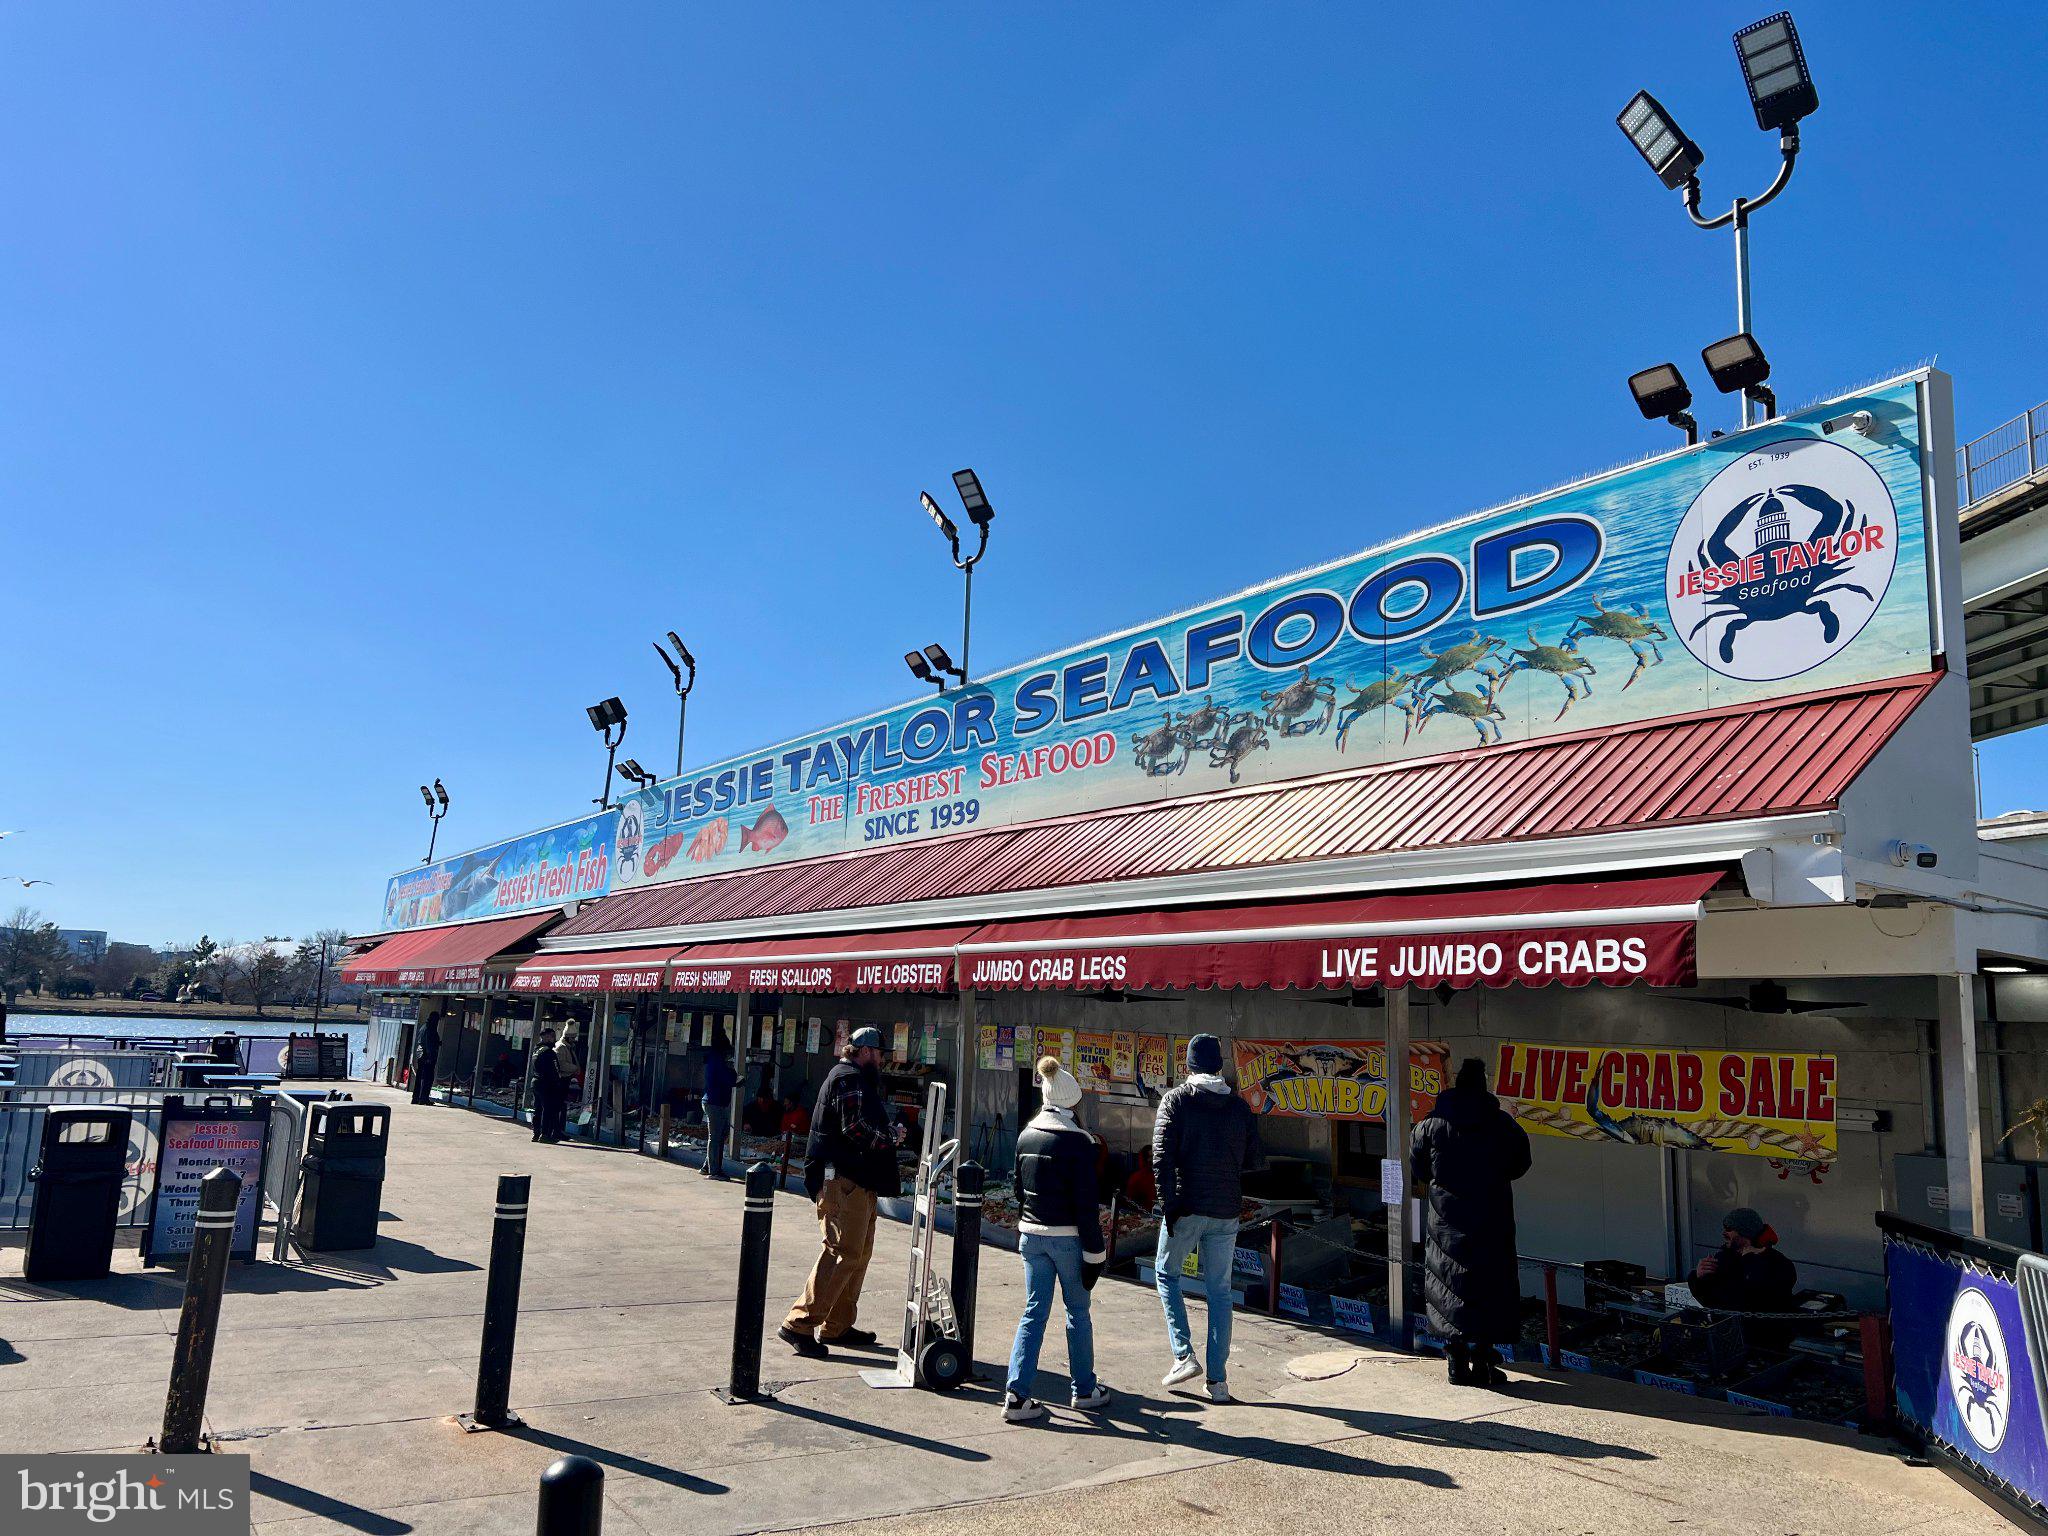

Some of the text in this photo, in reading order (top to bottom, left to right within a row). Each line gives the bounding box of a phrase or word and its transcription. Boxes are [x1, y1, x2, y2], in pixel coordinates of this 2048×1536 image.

[1748, 451, 1791, 471] EST. 1939
[1676, 525, 1885, 599] JESSIE TAYLOR
[1739, 571, 1812, 600] Seafood
[655, 512, 1607, 828] JESSIE TAYLOR SEAFOOD
[808, 731, 1117, 825] THE FRESHEST SEAFOOD
[864, 799, 980, 842] SINCE 1939
[493, 843, 607, 908] Jessie's Fresh Fish
[972, 956, 1127, 982] JUMBO CRAB LEGS
[1321, 937, 1647, 979] LIVE JUMBO CRABS
[574, 974, 600, 987] OYSTERS
[611, 972, 659, 987] FRESH FILLETS
[675, 971, 732, 986] FRESH SHRIMP
[750, 967, 832, 986] FRESH SCALLOPS
[857, 964, 942, 985] LIVE LOBSTER
[1081, 1054, 1105, 1063] KING
[1236, 1051, 1279, 1091] LIVE
[1495, 1044, 1836, 1122] LIVE CRAB SALE
[1270, 1077, 1387, 1115] JUMBO
[195, 1123, 238, 1135] Jessie's
[168, 1138, 260, 1150] Seafood Dinners
[178, 1157, 226, 1167] Monday
[1336, 1300, 1368, 1314] JUMBO
